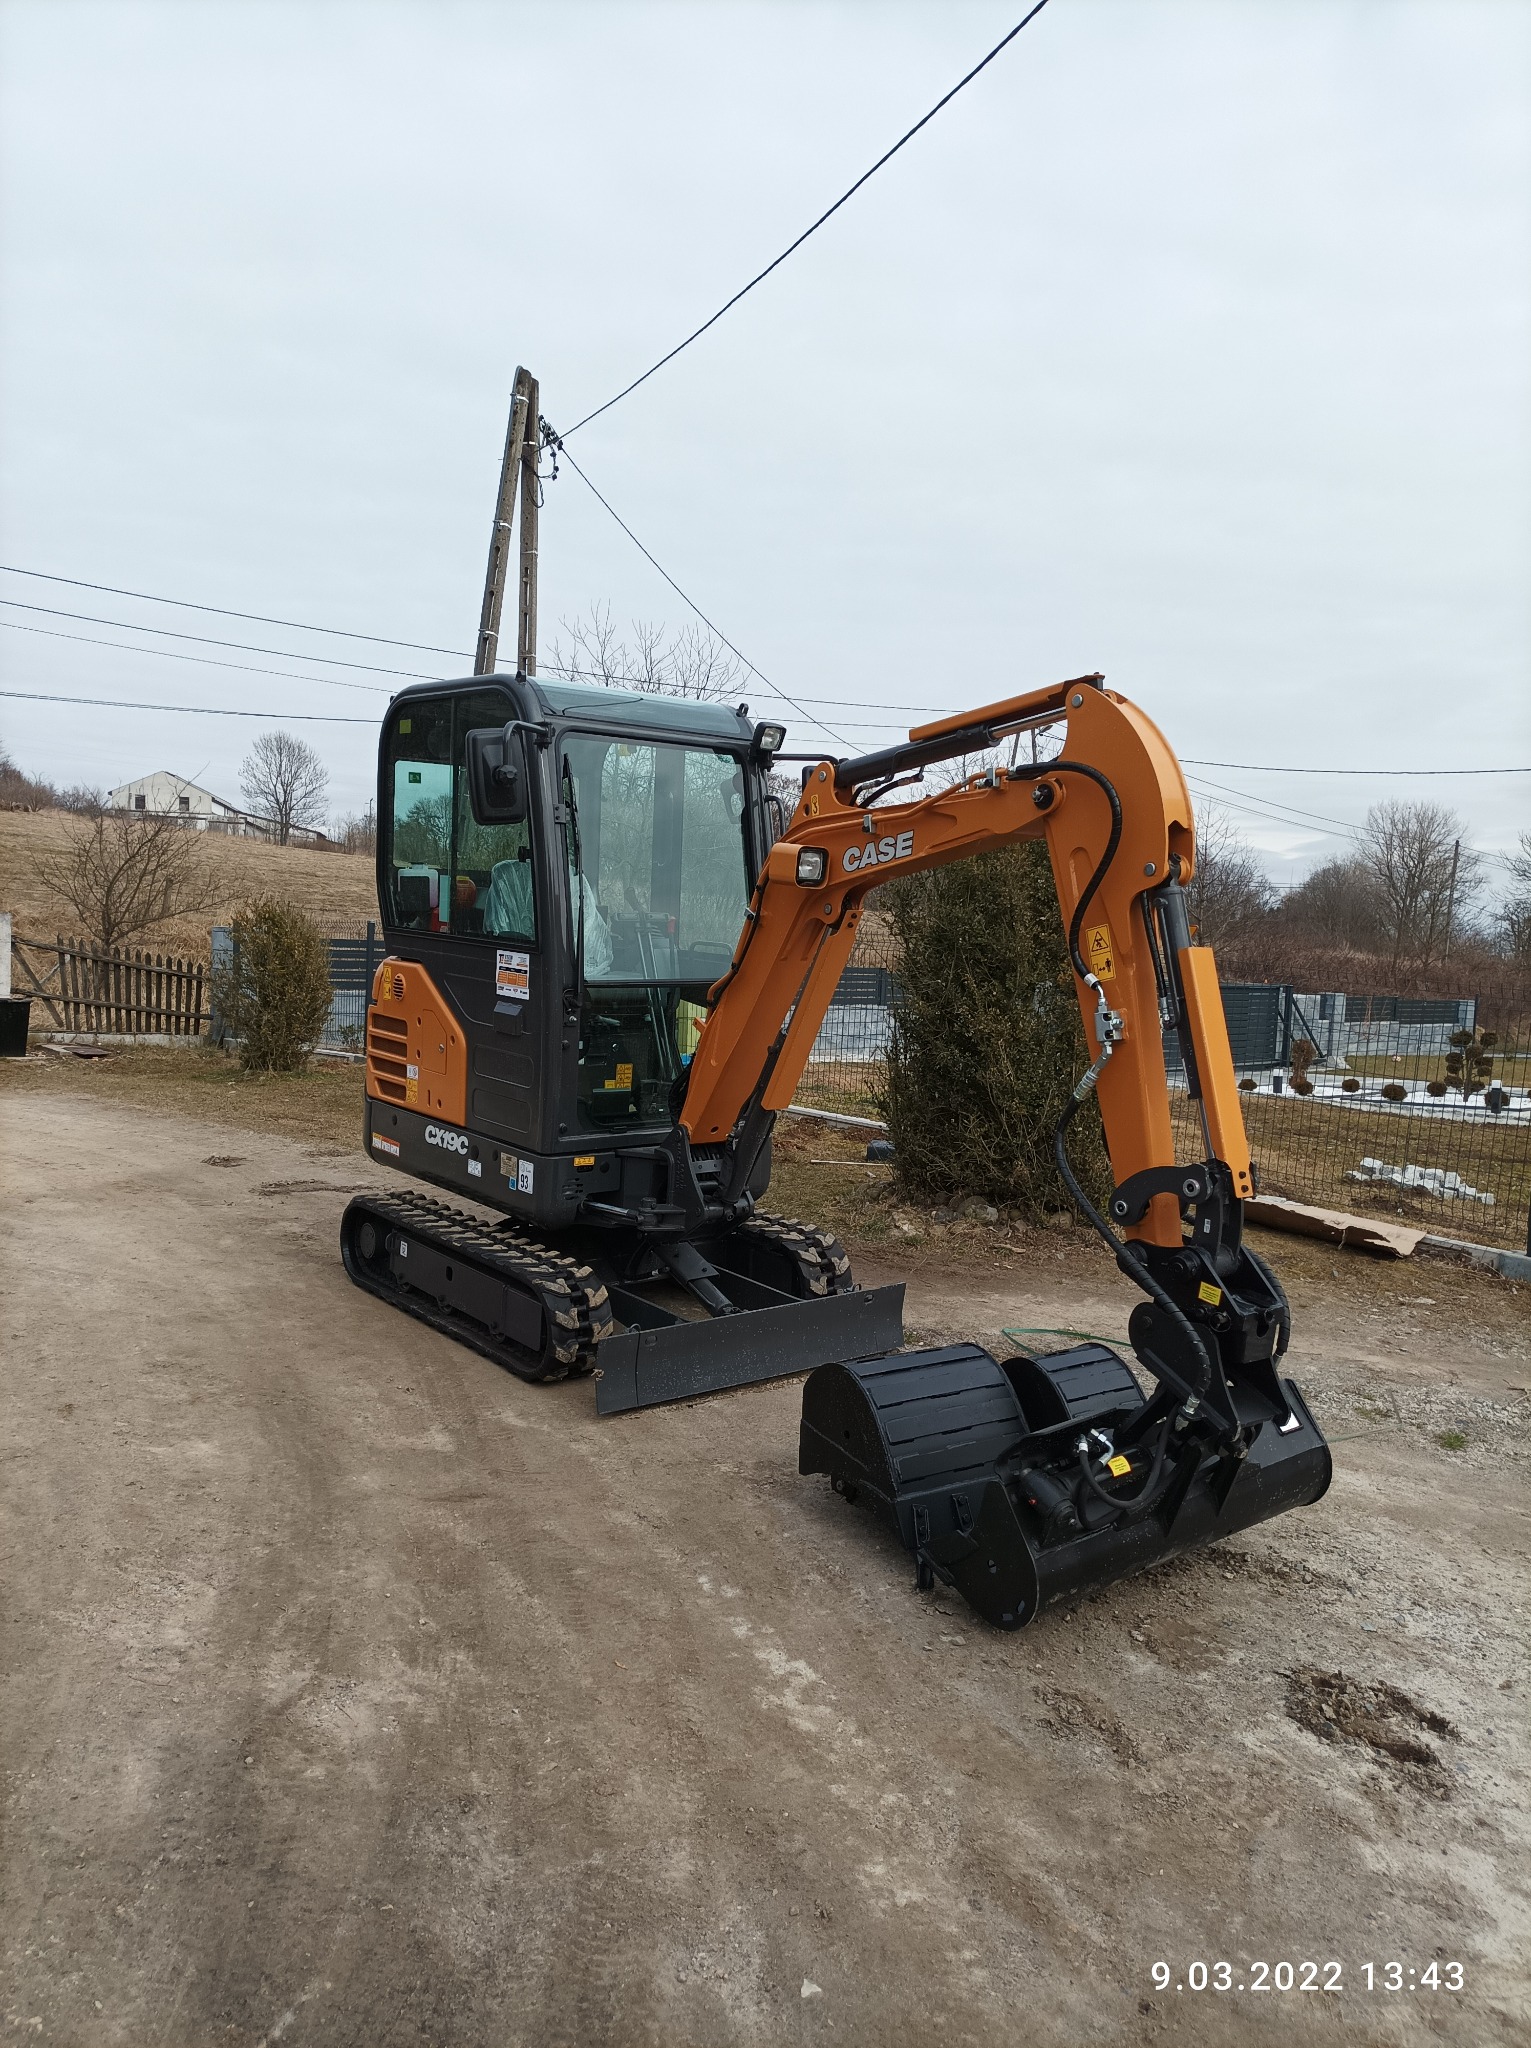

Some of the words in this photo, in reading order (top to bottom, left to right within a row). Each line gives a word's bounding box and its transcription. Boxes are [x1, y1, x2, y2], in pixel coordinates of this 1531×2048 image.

[842, 829, 914, 872] CASE
[424, 1124, 469, 1155] CX19C
[520, 1173, 529, 1190] 93
